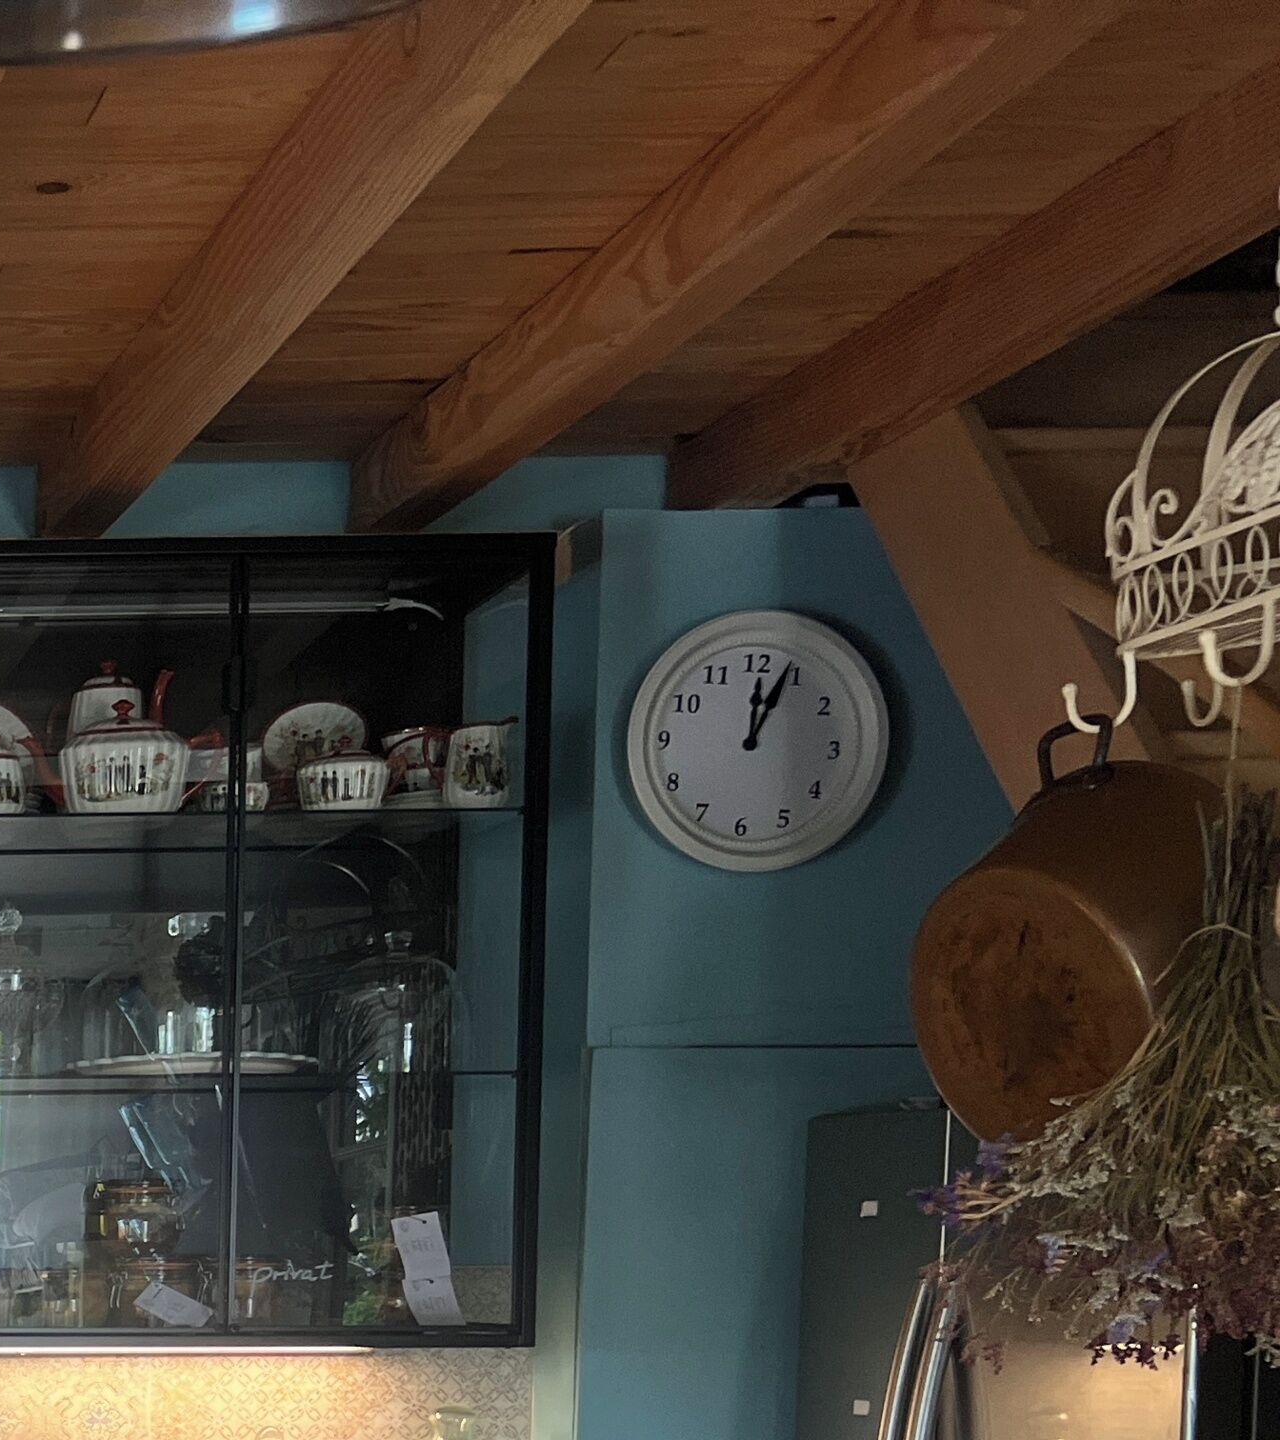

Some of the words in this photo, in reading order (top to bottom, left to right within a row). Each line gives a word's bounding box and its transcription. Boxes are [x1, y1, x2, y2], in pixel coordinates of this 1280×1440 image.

[744, 654, 771, 674] 12
[703, 666, 728, 685] 11
[790, 667, 801, 686] 1
[674, 694, 700, 713] 10
[817, 697, 831, 716] 2
[658, 730, 670, 750] 9
[827, 741, 840, 760] 3
[667, 773, 679, 791] 8
[809, 780, 821, 799] 4
[696, 804, 709, 822] 7
[777, 810, 790, 828] 5
[734, 817, 747, 836] 6
[250, 1258, 335, 1294] privat
